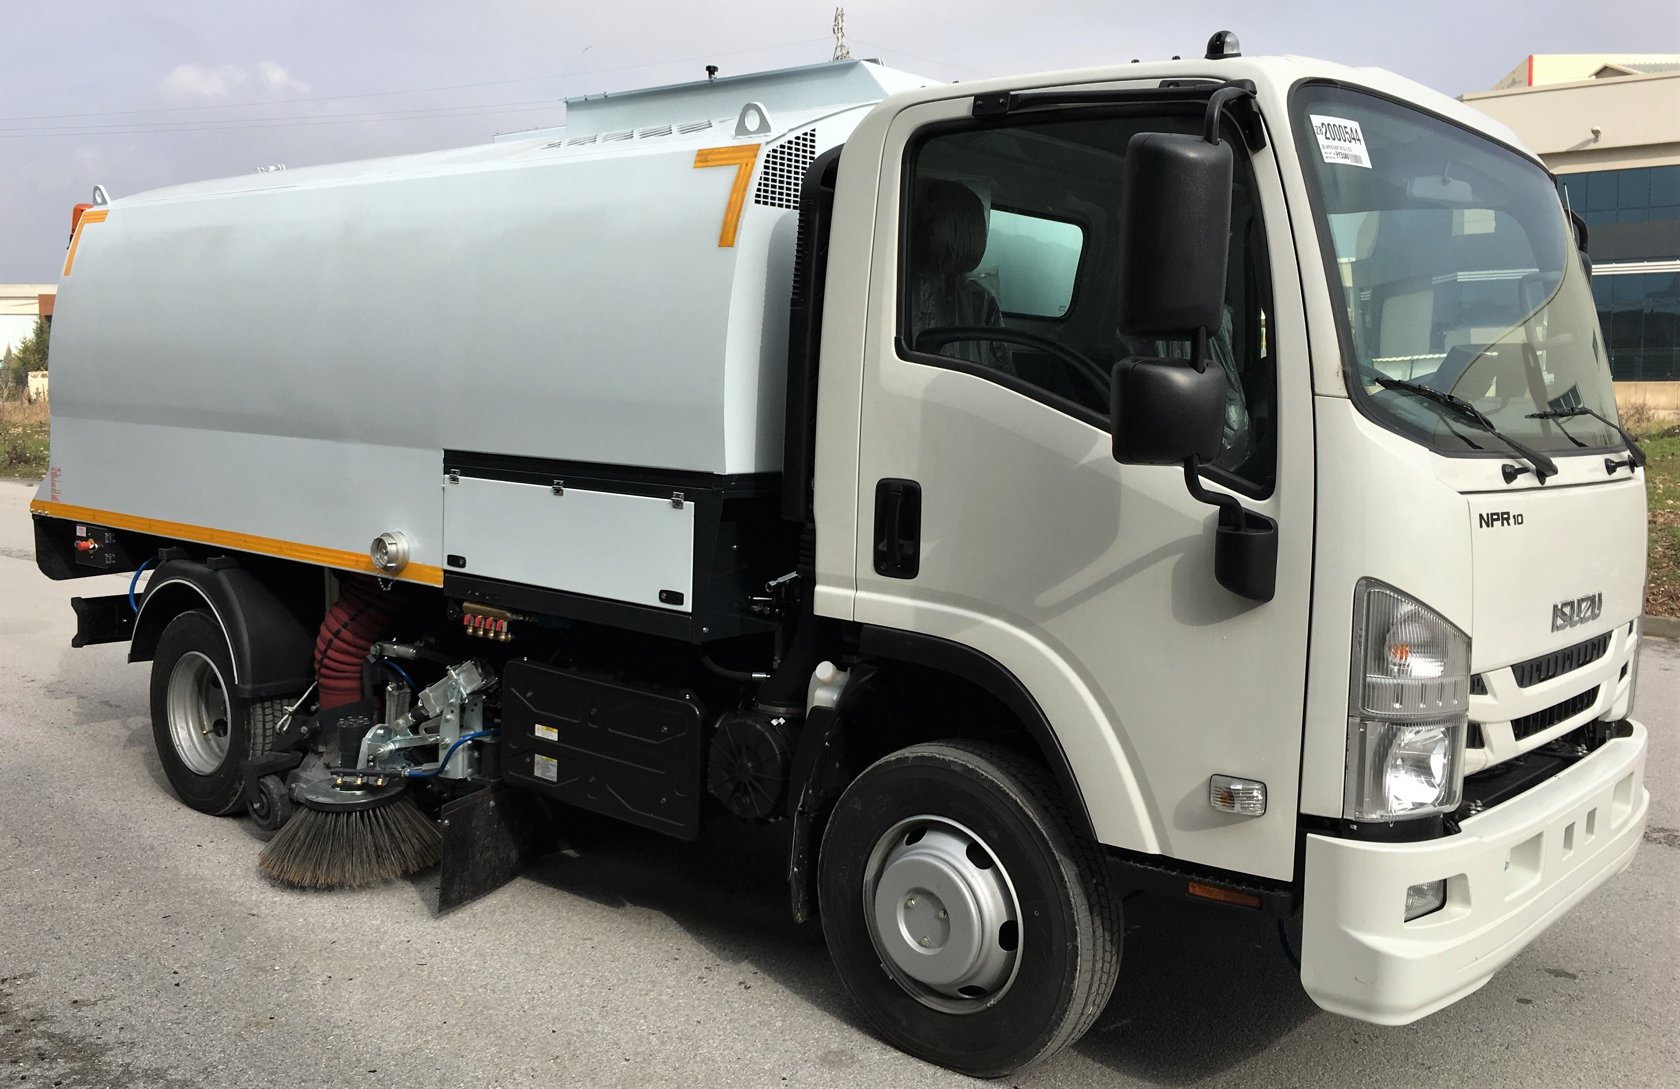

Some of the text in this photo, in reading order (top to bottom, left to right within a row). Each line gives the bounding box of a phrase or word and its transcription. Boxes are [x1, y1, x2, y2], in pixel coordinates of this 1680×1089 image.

[1321, 122, 1362, 145] 2000544
[1479, 511, 1524, 528] NPR 10
[1551, 591, 1603, 633] ISUZU
